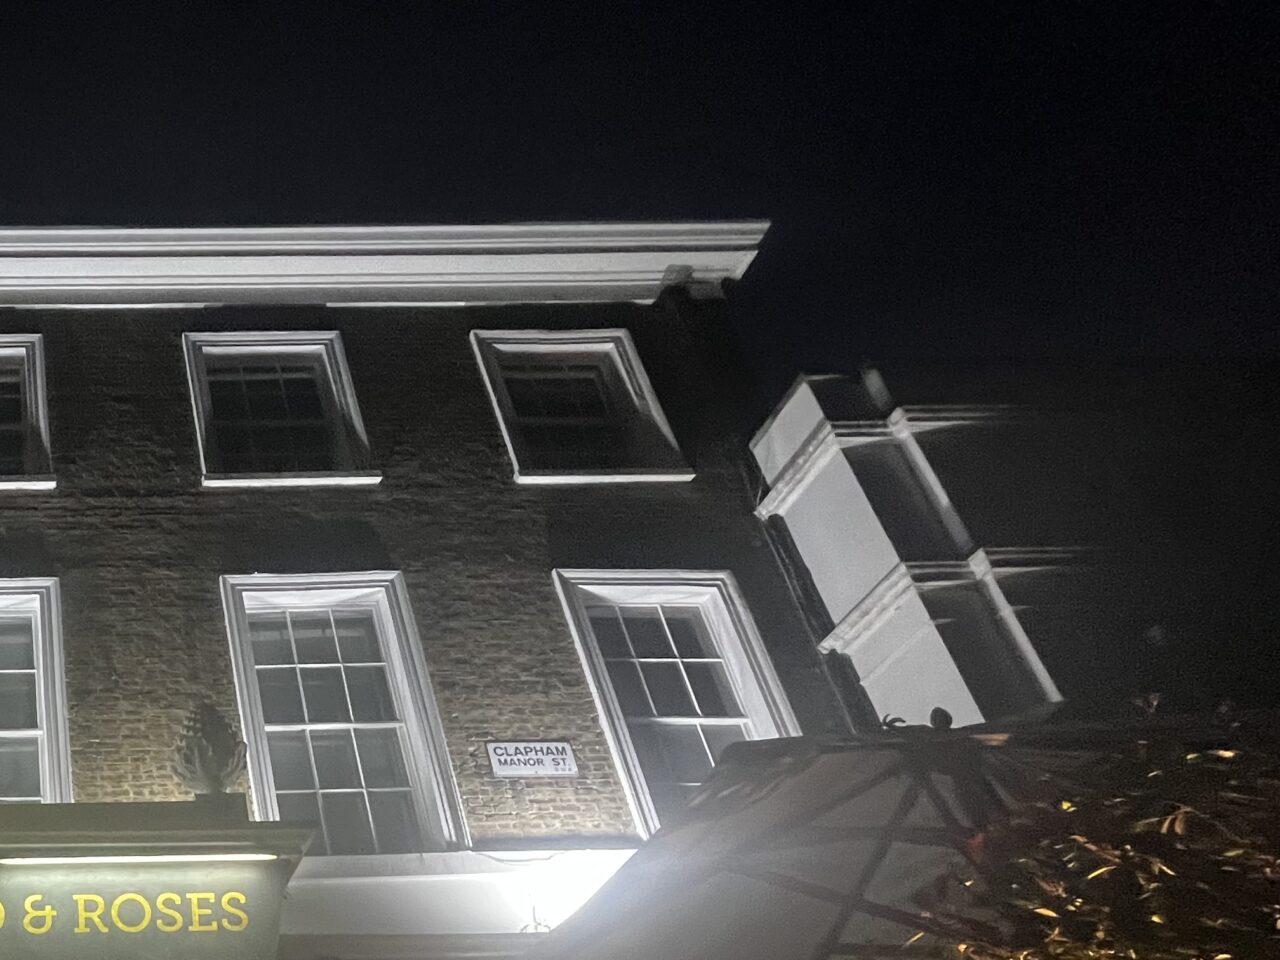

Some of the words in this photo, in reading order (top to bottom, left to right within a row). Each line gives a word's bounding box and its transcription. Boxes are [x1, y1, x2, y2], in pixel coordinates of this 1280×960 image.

[493, 746, 568, 757] CLAPHAM
[498, 757, 545, 767] MANOR
[22, 894, 58, 935] &
[72, 891, 250, 934] ROSES
